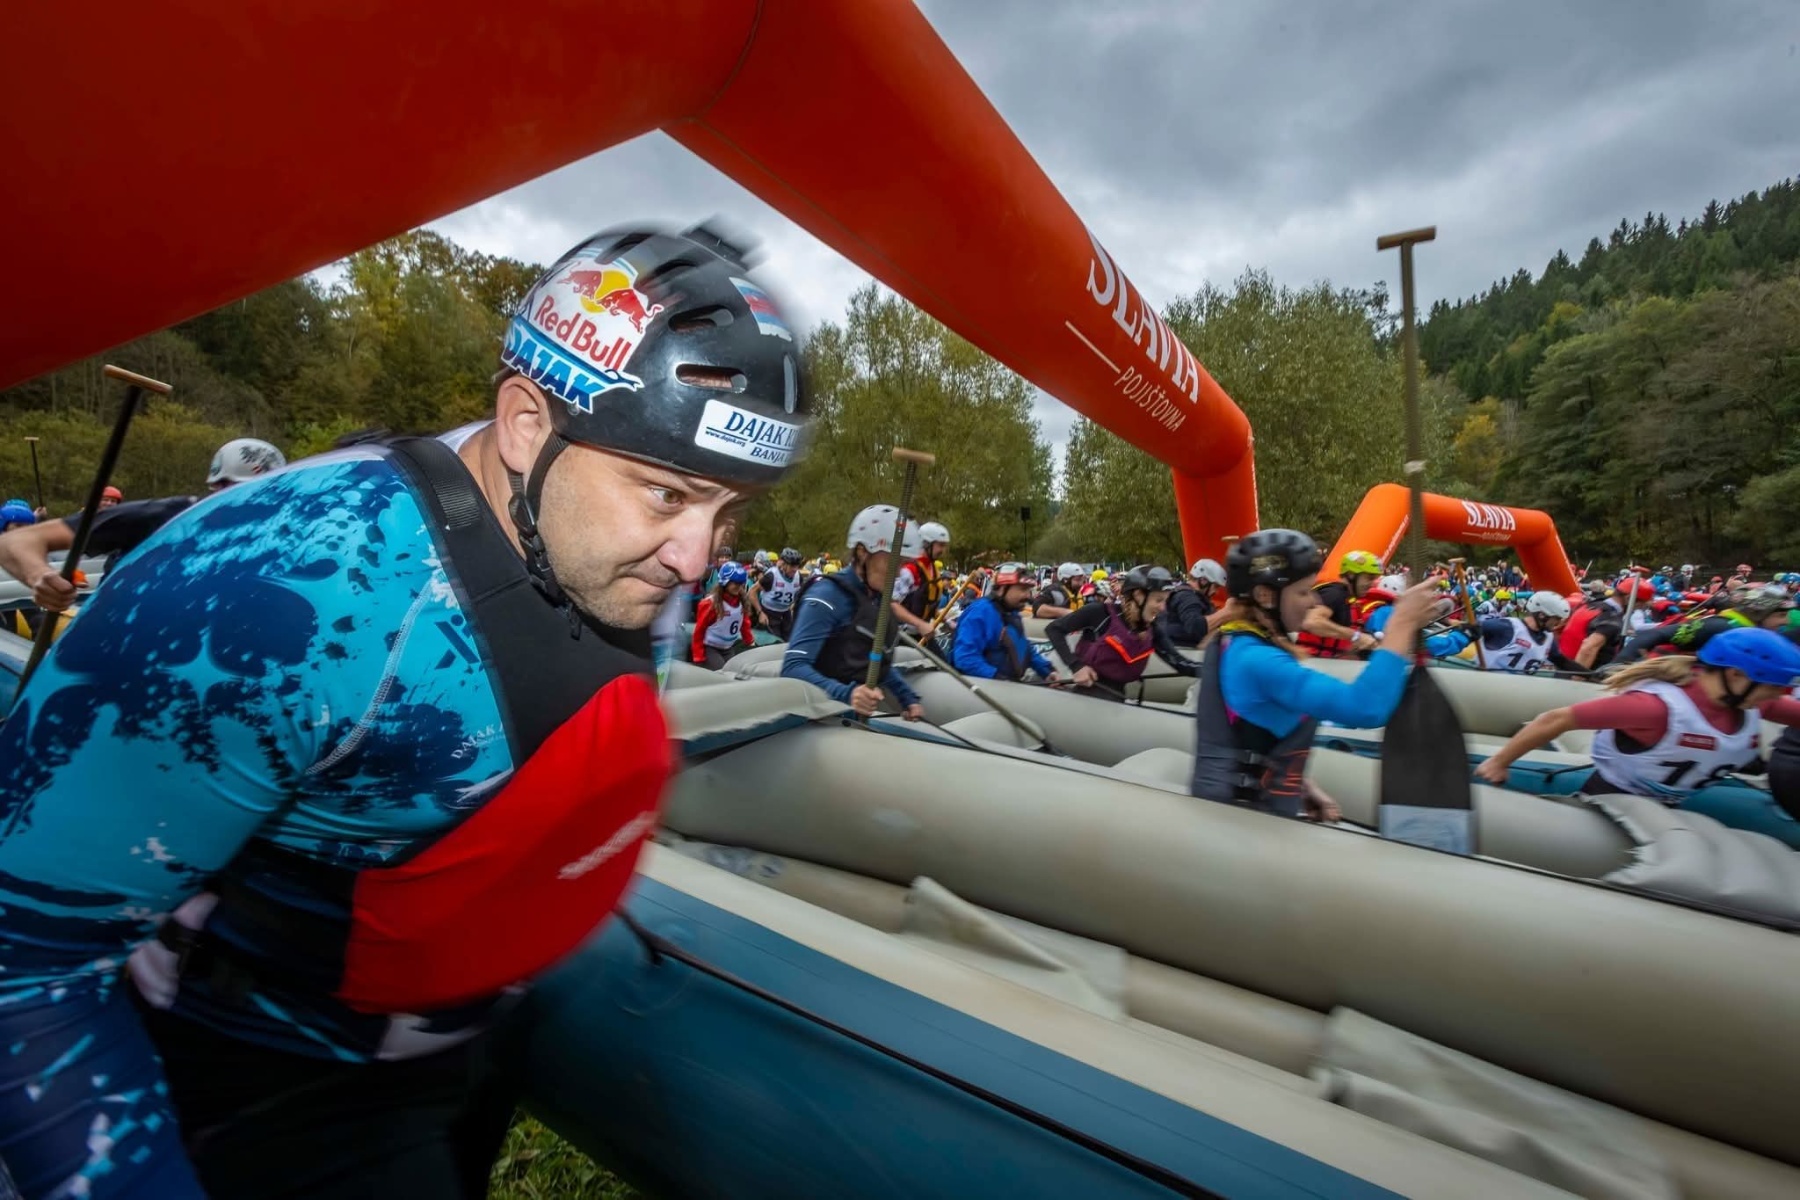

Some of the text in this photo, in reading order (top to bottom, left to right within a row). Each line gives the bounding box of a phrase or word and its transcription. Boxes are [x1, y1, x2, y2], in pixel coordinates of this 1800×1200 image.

[534, 294, 632, 371] Red Bull
[1086, 231, 1200, 404] SLAVIA
[1114, 365, 1187, 432] POJIŠŤOVNA
[724, 411, 787, 445] DAJAK
[1461, 500, 1516, 531] SLAVIA
[771, 591, 793, 603] 23
[729, 620, 739, 635] 6
